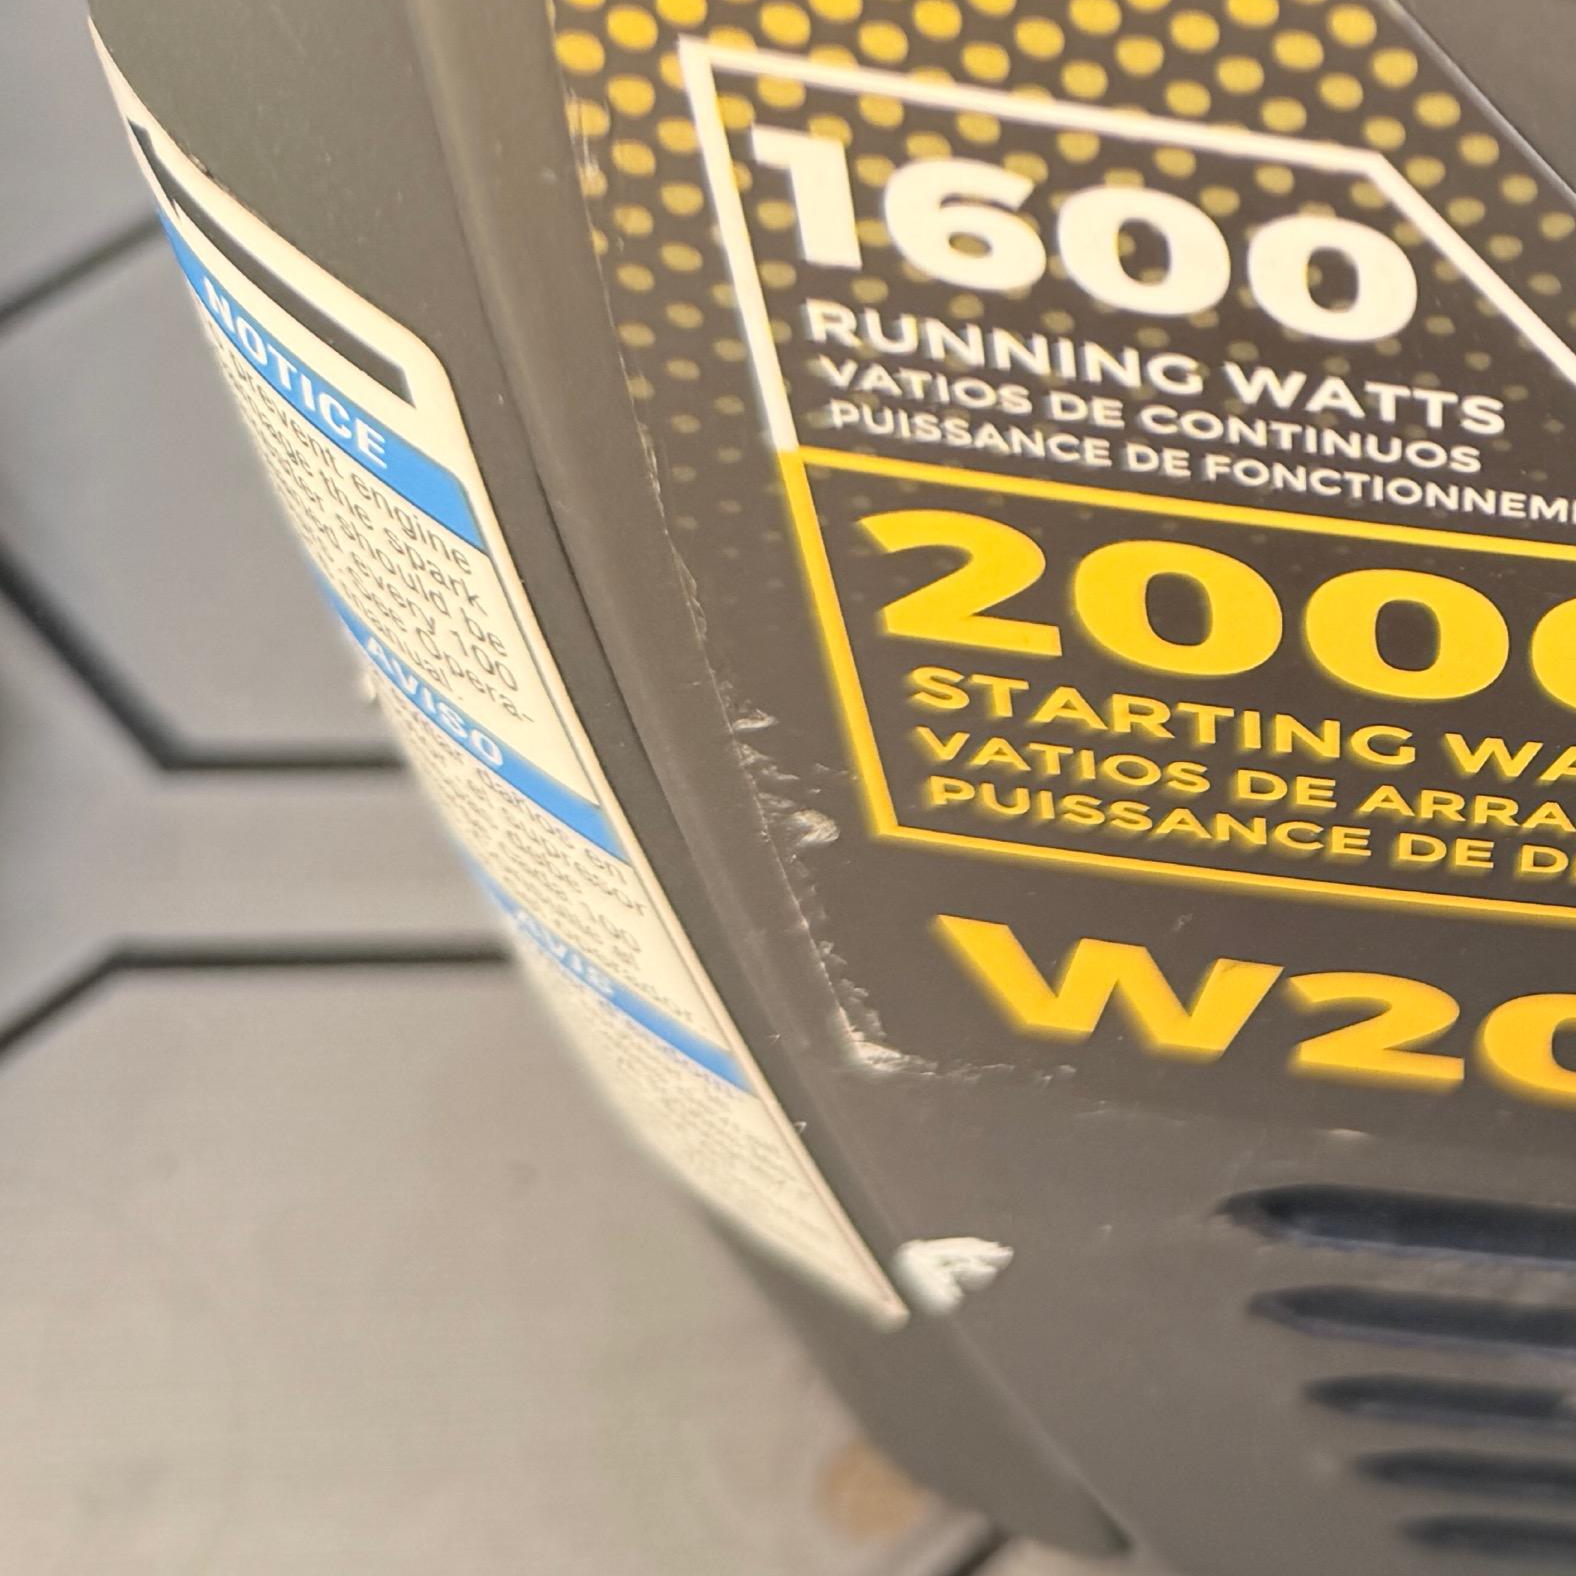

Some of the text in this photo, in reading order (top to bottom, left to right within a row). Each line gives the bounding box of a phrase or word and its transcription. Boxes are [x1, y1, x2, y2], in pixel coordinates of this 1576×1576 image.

[750, 121, 1418, 343] 1600
[202, 274, 388, 470] NOTICE
[804, 296, 1507, 436] RUNNING WATTS
[816, 356, 1483, 476] VATIOS DE CONTINUOS
[826, 397, 1113, 469] PUISSANCE
[1126, 441, 1192, 480] DE
[316, 463, 375, 533] the
[381, 522, 487, 616] spark
[334, 508, 451, 621] should
[460, 606, 508, 659] be
[347, 466, 475, 580] engine
[349, 548, 522, 699] every 100
[412, 623, 533, 721] Opera-
[366, 635, 504, 767] AVISO
[904, 664, 1419, 768] STARTING
[914, 723, 1214, 797] VATIOS
[1233, 766, 1343, 813] DE
[926, 775, 1375, 862] PUISSANCE
[1394, 826, 1498, 871] DE
